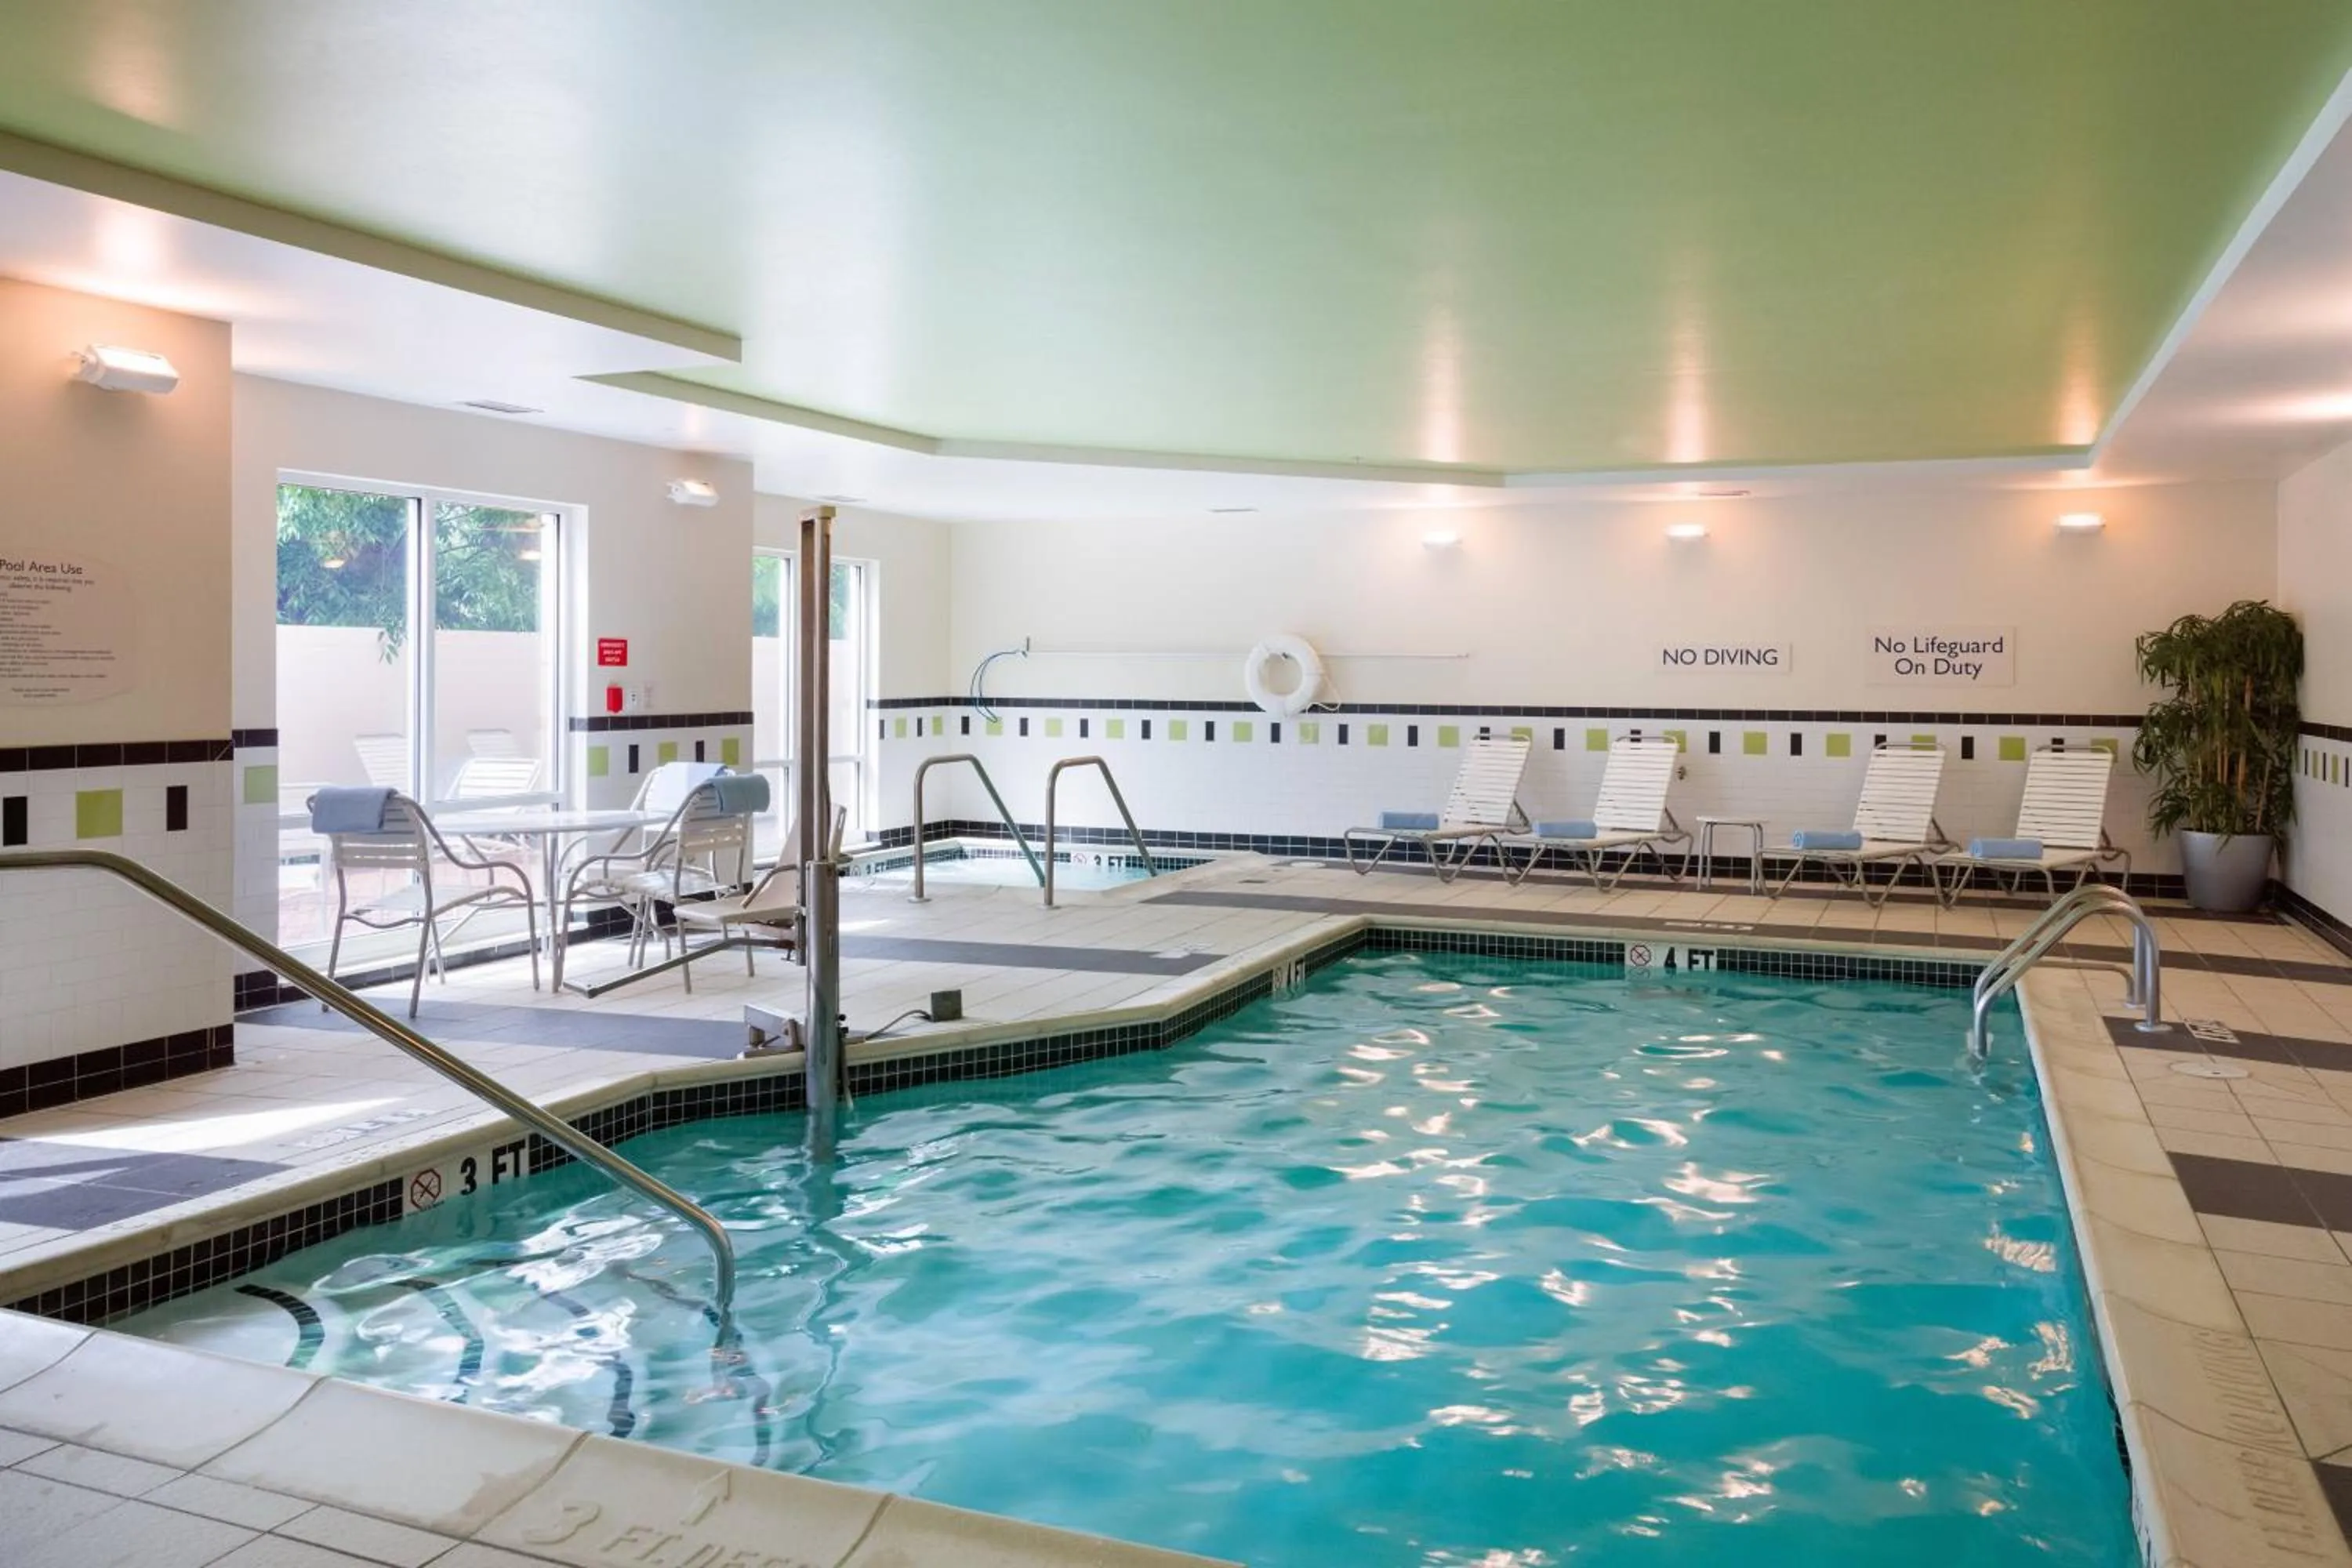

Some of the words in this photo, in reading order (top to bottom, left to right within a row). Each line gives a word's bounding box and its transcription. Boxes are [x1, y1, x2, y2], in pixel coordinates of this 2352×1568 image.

[0, 558, 24, 572] Pool
[29, 561, 56, 573] Area
[60, 563, 82, 575] Use
[1663, 648, 1697, 666] NO
[1704, 648, 1778, 666] DIVING
[1875, 636, 1907, 654] No
[1913, 636, 2004, 659] Lifeguard
[1894, 657, 1926, 676] On
[1933, 657, 1983, 681] Duty
[1108, 855, 1123, 870] FT
[1664, 946, 1677, 969] 4
[1687, 948, 1715, 971] FT
[460, 1156, 477, 1197] 3
[491, 1138, 527, 1187] FT
[522, 1500, 602, 1546] 3
[600, 1525, 684, 1565] FT.
[676, 1543, 817, 1568] DE
